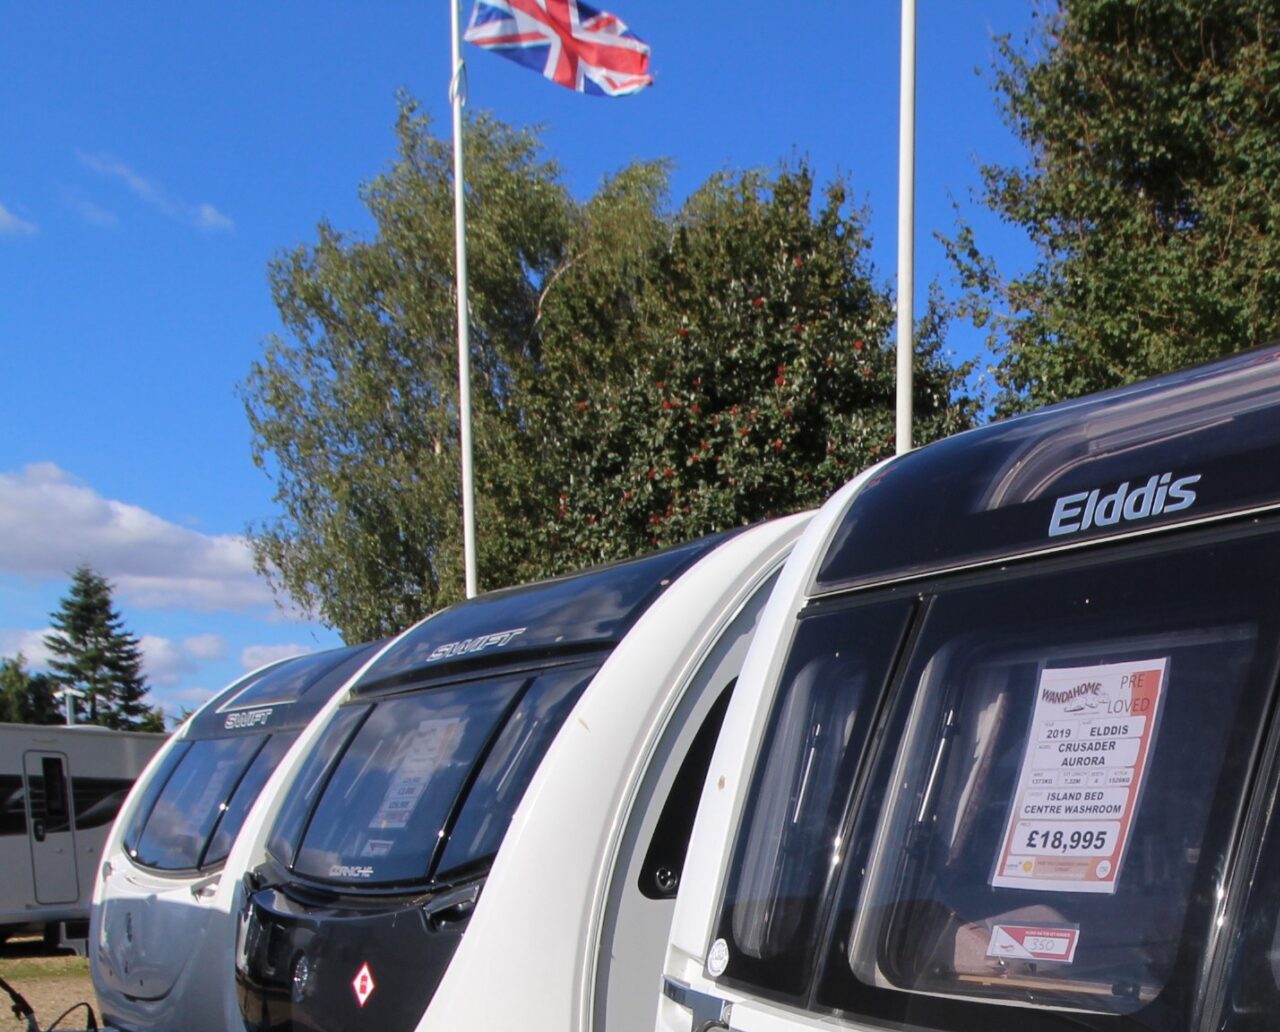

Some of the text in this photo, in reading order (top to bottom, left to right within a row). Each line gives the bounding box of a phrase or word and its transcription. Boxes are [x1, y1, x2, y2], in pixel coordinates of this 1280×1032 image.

[1048, 471, 1202, 537] Elddis
[426, 627, 527, 662] SWIFT
[1120, 673, 1146, 690] PRE
[1041, 681, 1103, 705] WANDAHOME
[1107, 697, 1151, 715] LOVED
[224, 708, 273, 729] SWIFT
[1046, 725, 1129, 739] 2019 ELDDIS
[1058, 741, 1116, 753] CRUSADER
[1060, 756, 1106, 767] AURORA
[1046, 792, 1082, 801] ISLAND
[1084, 791, 1104, 800] BED
[1024, 804, 1122, 814] CENTRE WASHROOM
[1026, 830, 1108, 853] £18,995
